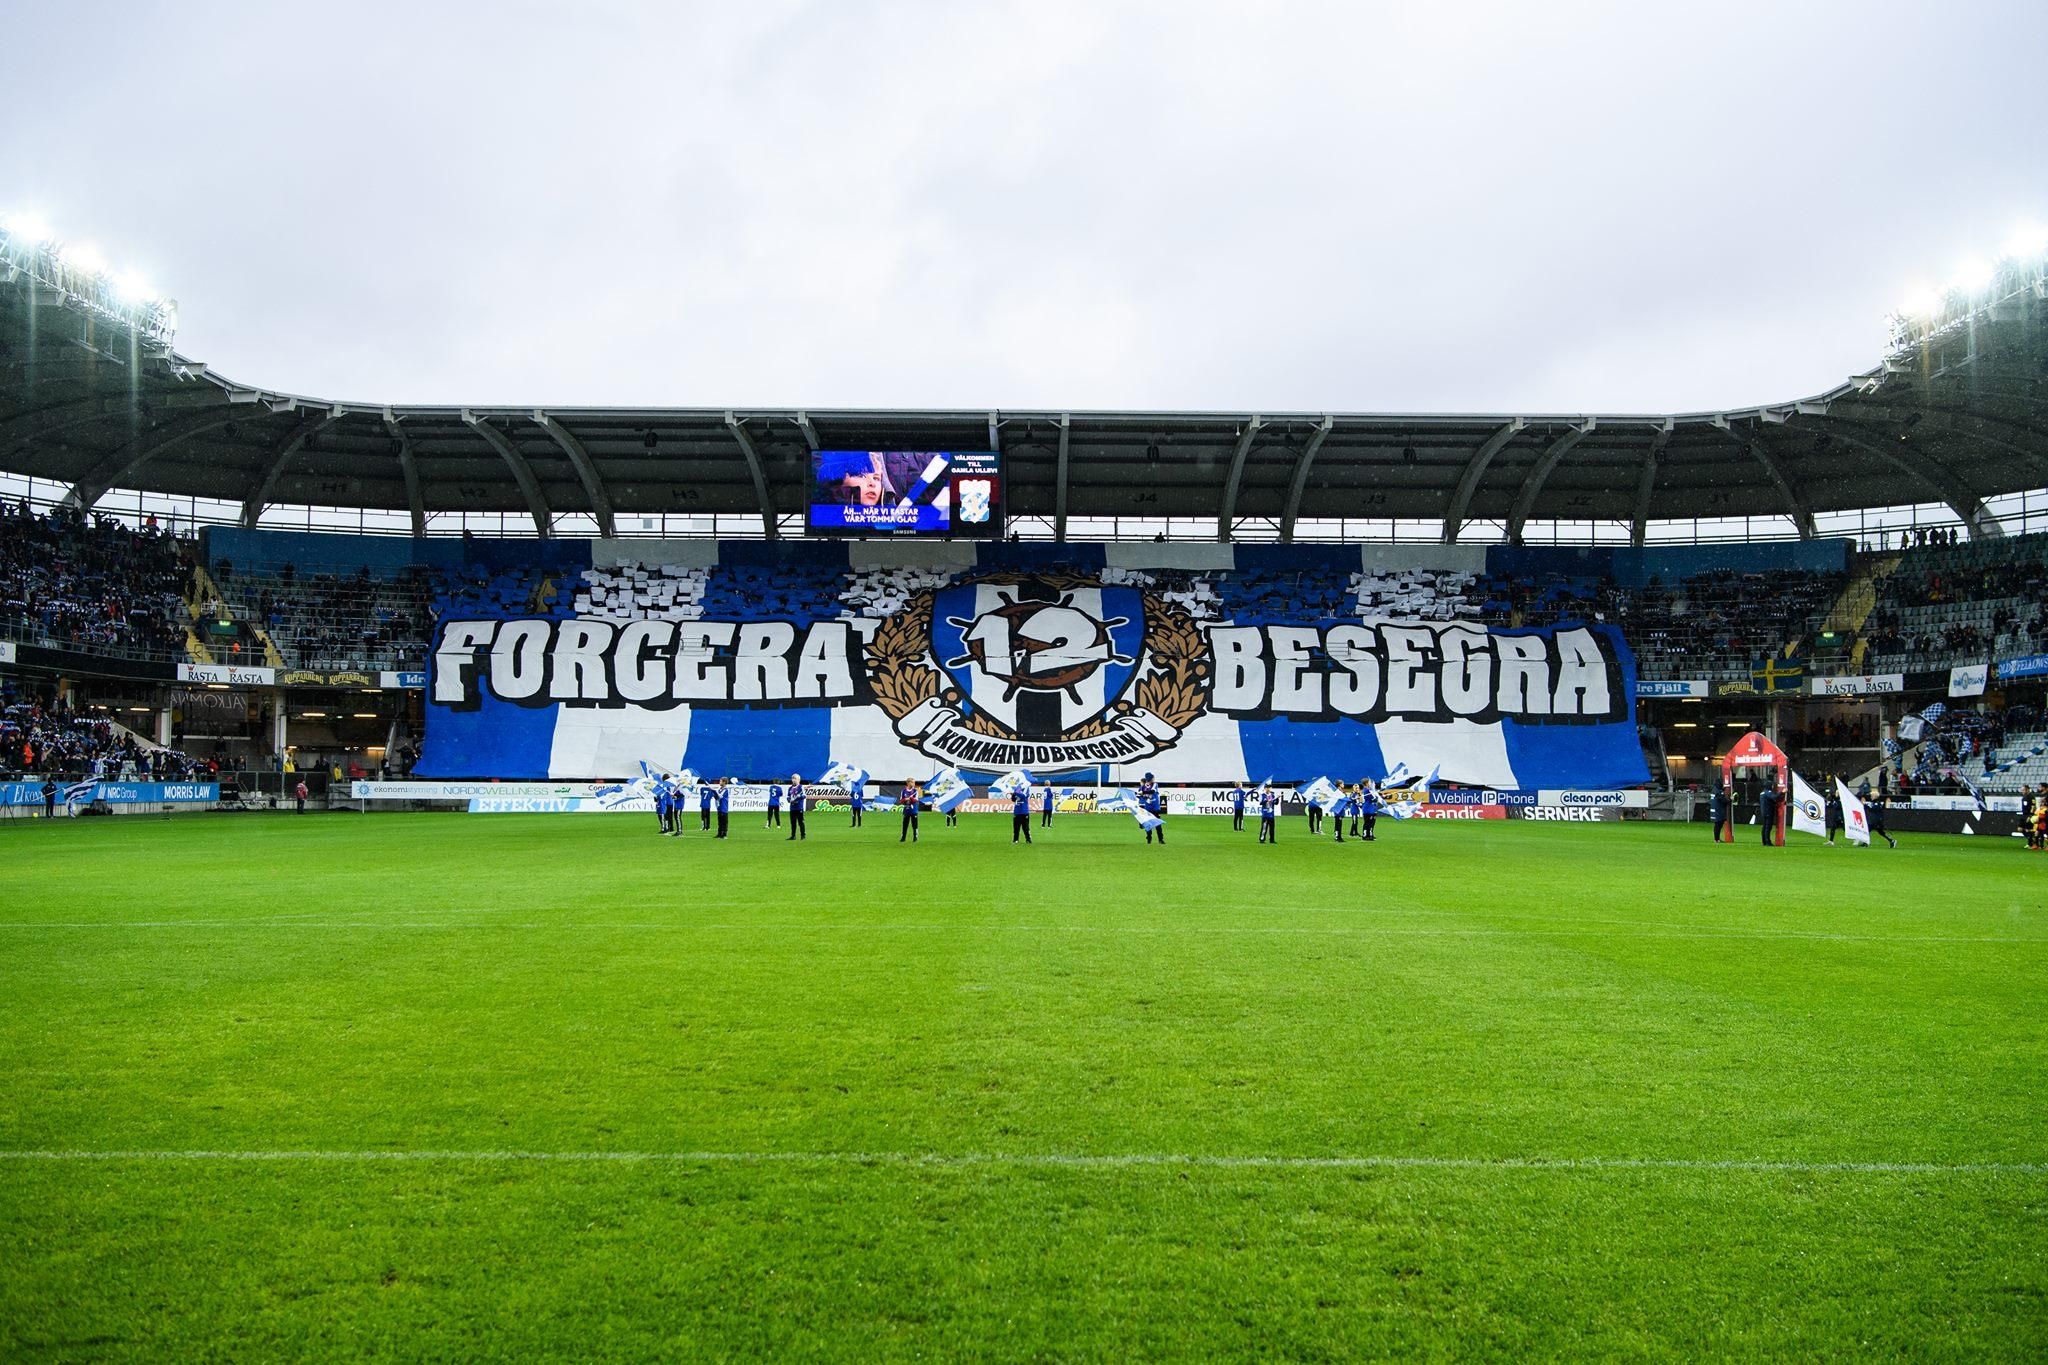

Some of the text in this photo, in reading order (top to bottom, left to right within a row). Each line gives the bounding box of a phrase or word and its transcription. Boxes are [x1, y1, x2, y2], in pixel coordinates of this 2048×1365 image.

[863, 506, 879, 516] NÄR
[881, 507, 889, 516] VI
[890, 507, 919, 516] KASTAR
[866, 515, 896, 523] TOMMA
[898, 515, 918, 523] GLAS
[968, 606, 1109, 677] 12
[434, 619, 855, 702] FORCERA
[1209, 624, 1611, 715] BESEGRA
[187, 671, 219, 682] RASTA
[229, 673, 263, 684] RASTA
[406, 674, 426, 684] Idr
[1655, 683, 1682, 695] Fjäll
[1825, 683, 1858, 694] RASTA
[1865, 681, 1894, 692] RASTA
[931, 728, 1146, 765] KOMMANDOBRYGGAN
[164, 785, 210, 800] MORRIS LAW
[703, 790, 709, 800] 7
[1432, 792, 1535, 804] Weblink IP Phone
[1563, 792, 1623, 804] clean park
[478, 799, 569, 812] EFFEKTIV
[1414, 805, 1484, 819] Scandic
[1524, 806, 1602, 822] SERNEKE
